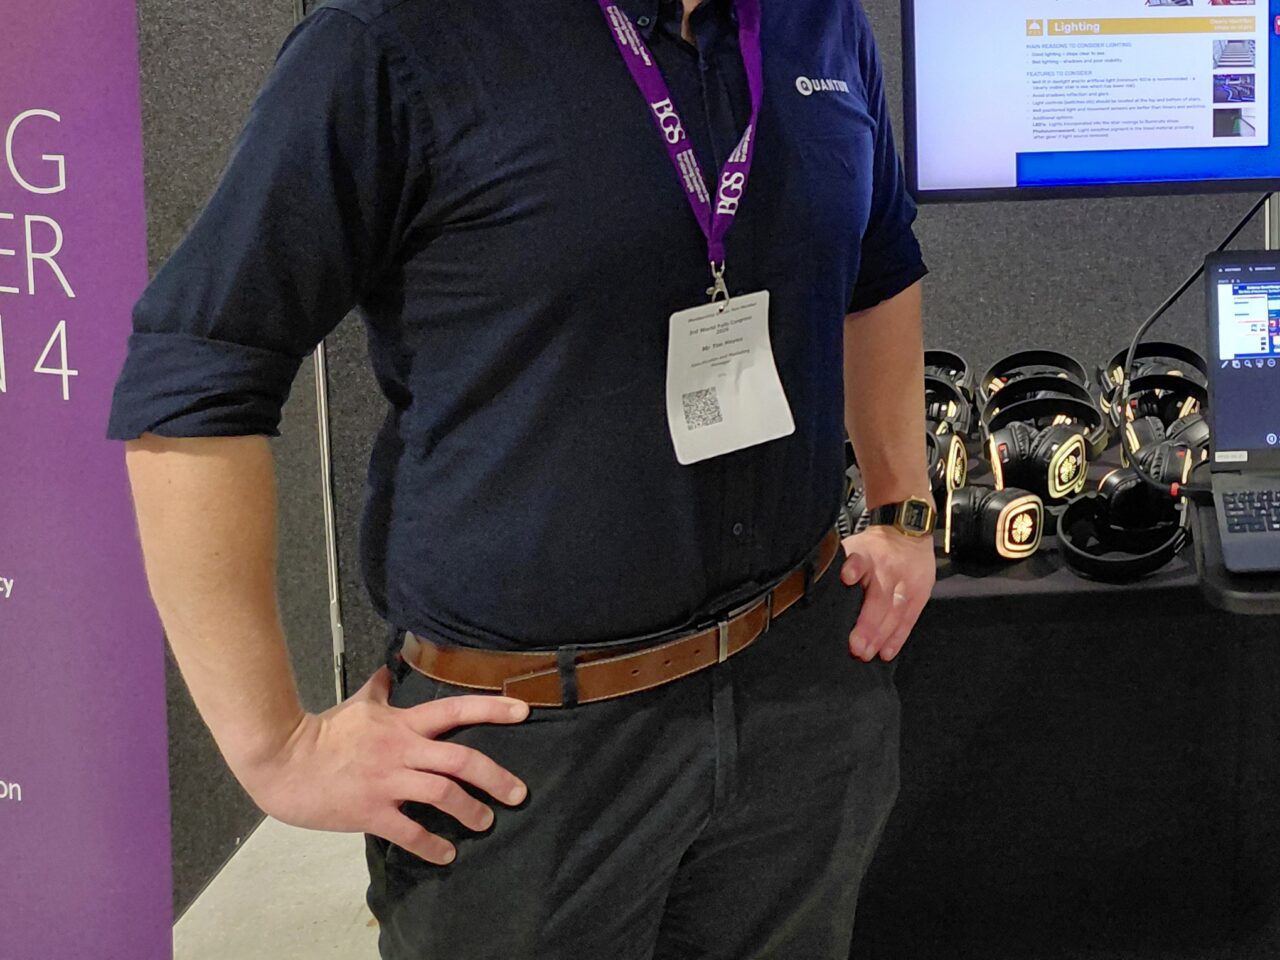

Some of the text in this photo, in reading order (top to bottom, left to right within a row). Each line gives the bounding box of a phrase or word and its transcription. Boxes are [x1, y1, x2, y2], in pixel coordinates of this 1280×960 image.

[1054, 21, 1100, 34] Lighting
[651, 97, 686, 144] BGS
[6, 109, 66, 194] G
[717, 172, 744, 216] BGS
[33, 320, 78, 401] 4
